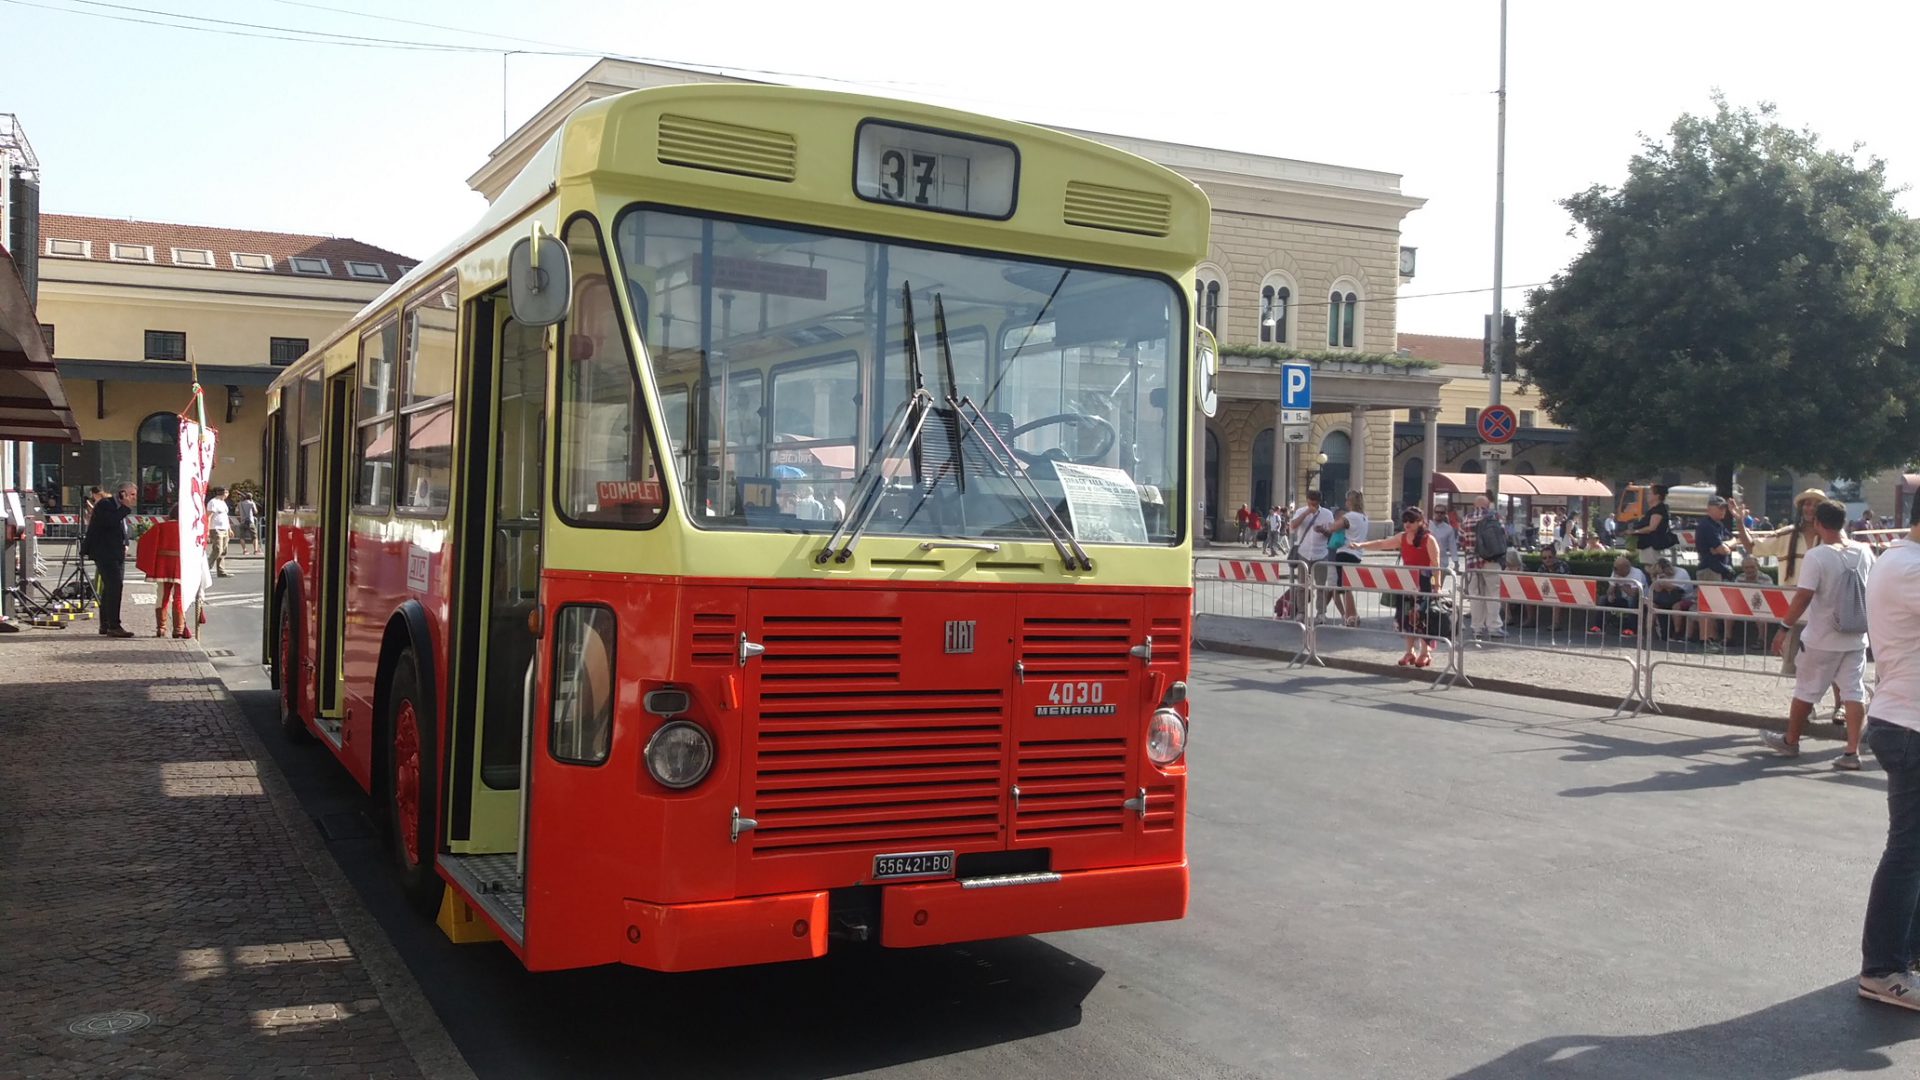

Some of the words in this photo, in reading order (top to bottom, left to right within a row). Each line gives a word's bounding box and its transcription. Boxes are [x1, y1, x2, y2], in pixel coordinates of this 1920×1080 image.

[881, 150, 936, 204] 37
[1288, 368, 1306, 404] P
[945, 620, 977, 651] FIAT
[1048, 682, 1103, 704] 4030
[1037, 705, 1115, 716] MENARINI
